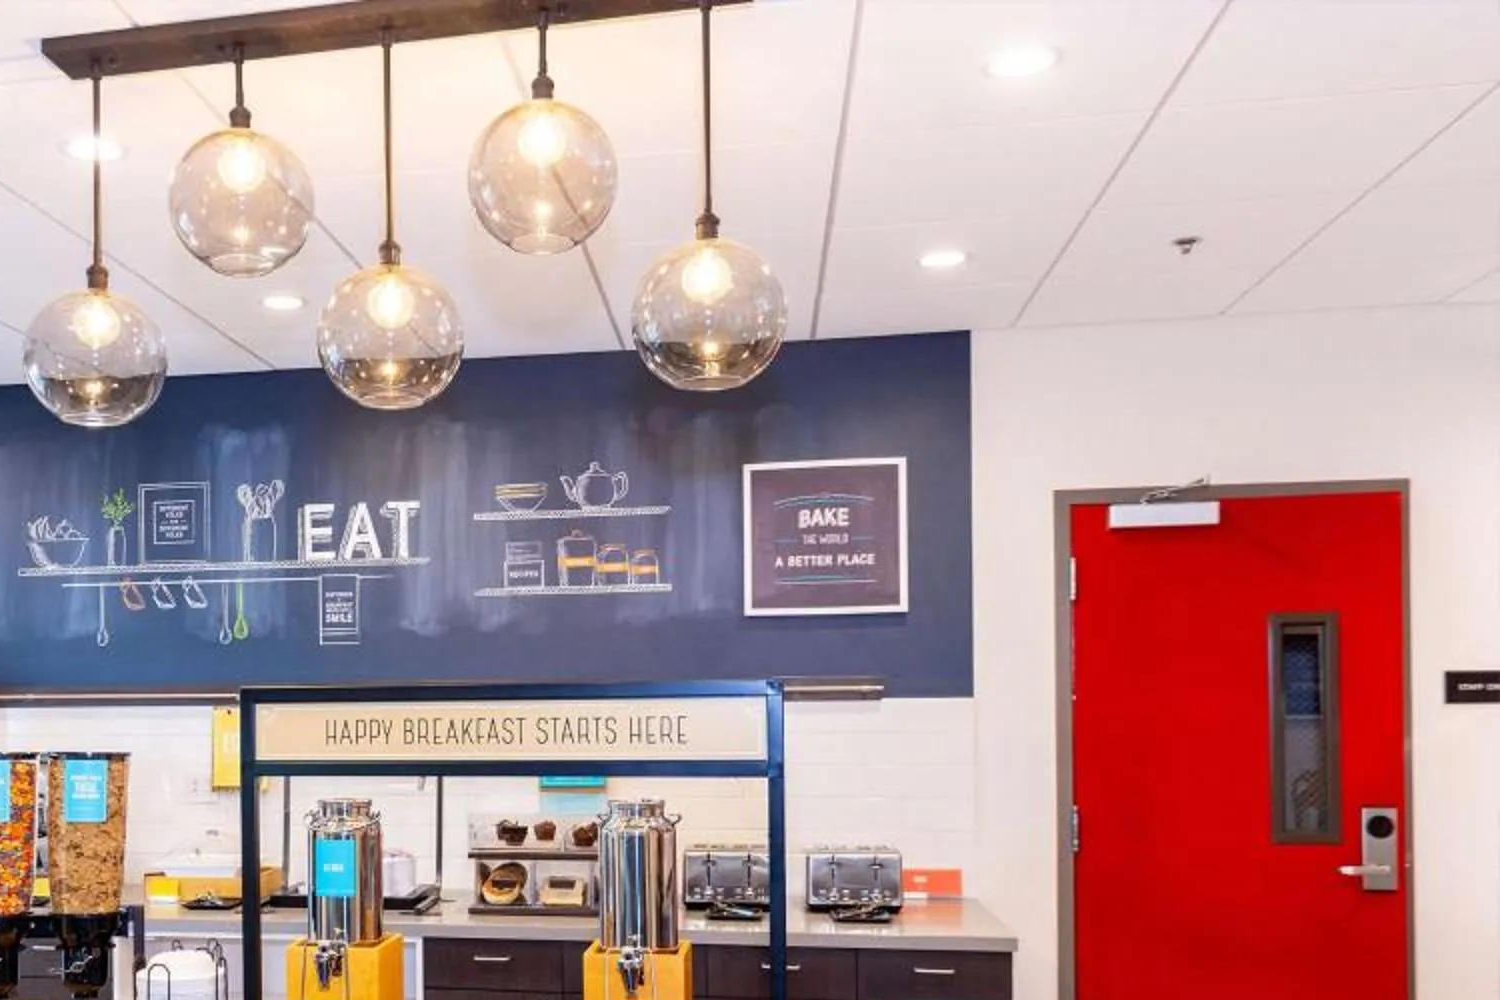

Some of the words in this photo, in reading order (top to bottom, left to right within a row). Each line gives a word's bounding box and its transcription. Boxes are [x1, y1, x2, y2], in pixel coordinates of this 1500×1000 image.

[298, 500, 421, 561] EAT
[798, 507, 851, 529] BAKE
[775, 556, 784, 568] A
[787, 553, 834, 568] BETTER
[837, 553, 876, 566] PLACE
[325, 718, 393, 746] HAPPY
[403, 717, 527, 746] BREAKFAST
[535, 716, 618, 745] STARTS
[629, 715, 688, 745] HERE
